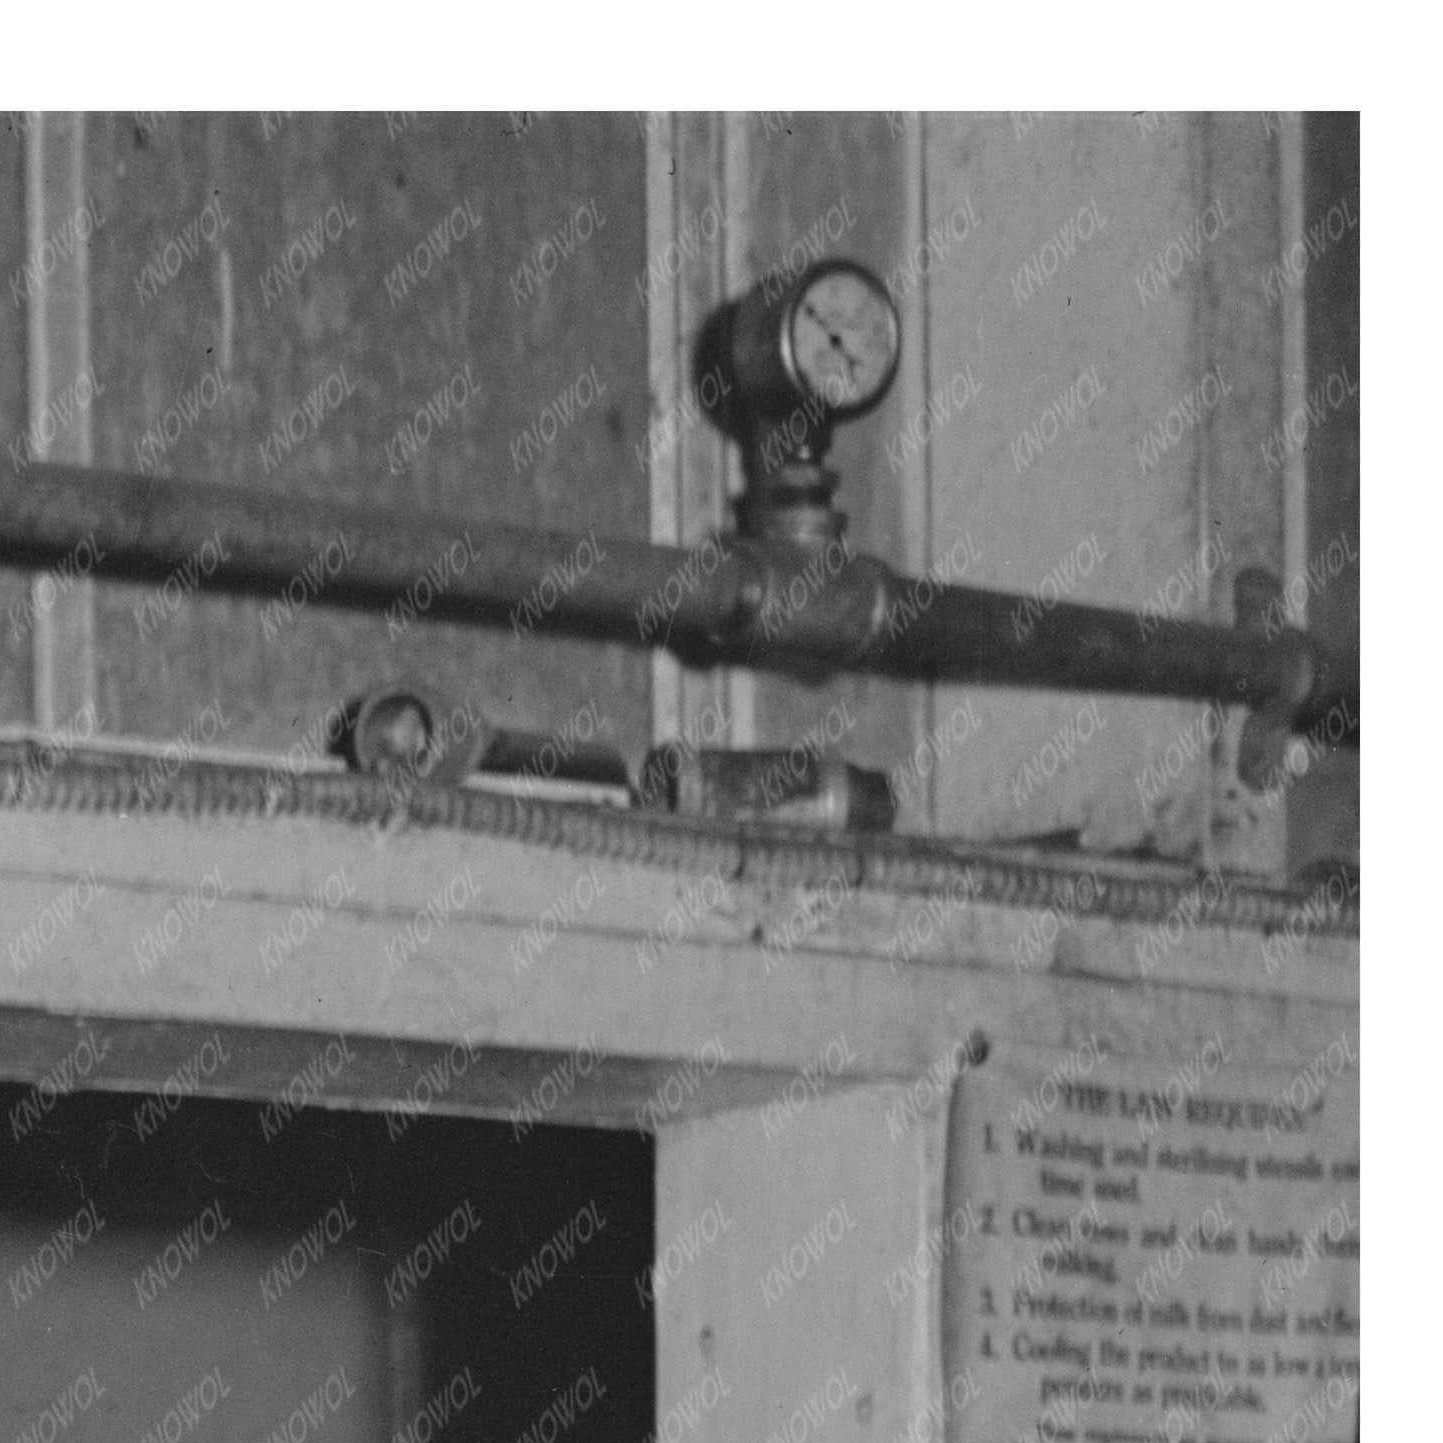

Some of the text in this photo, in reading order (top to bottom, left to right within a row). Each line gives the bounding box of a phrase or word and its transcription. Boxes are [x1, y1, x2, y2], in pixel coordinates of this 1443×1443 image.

[1060, 1080, 1111, 1117] THE
[1118, 1090, 1176, 1121] LAW
[1112, 1142, 1148, 1170] and
[1013, 1208, 1071, 1242] Clean
[1141, 1222, 1178, 1252] and
[1013, 1287, 1118, 1322] Protection
[1197, 1299, 1244, 1332] from
[1013, 1333, 1092, 1372] Cooling
